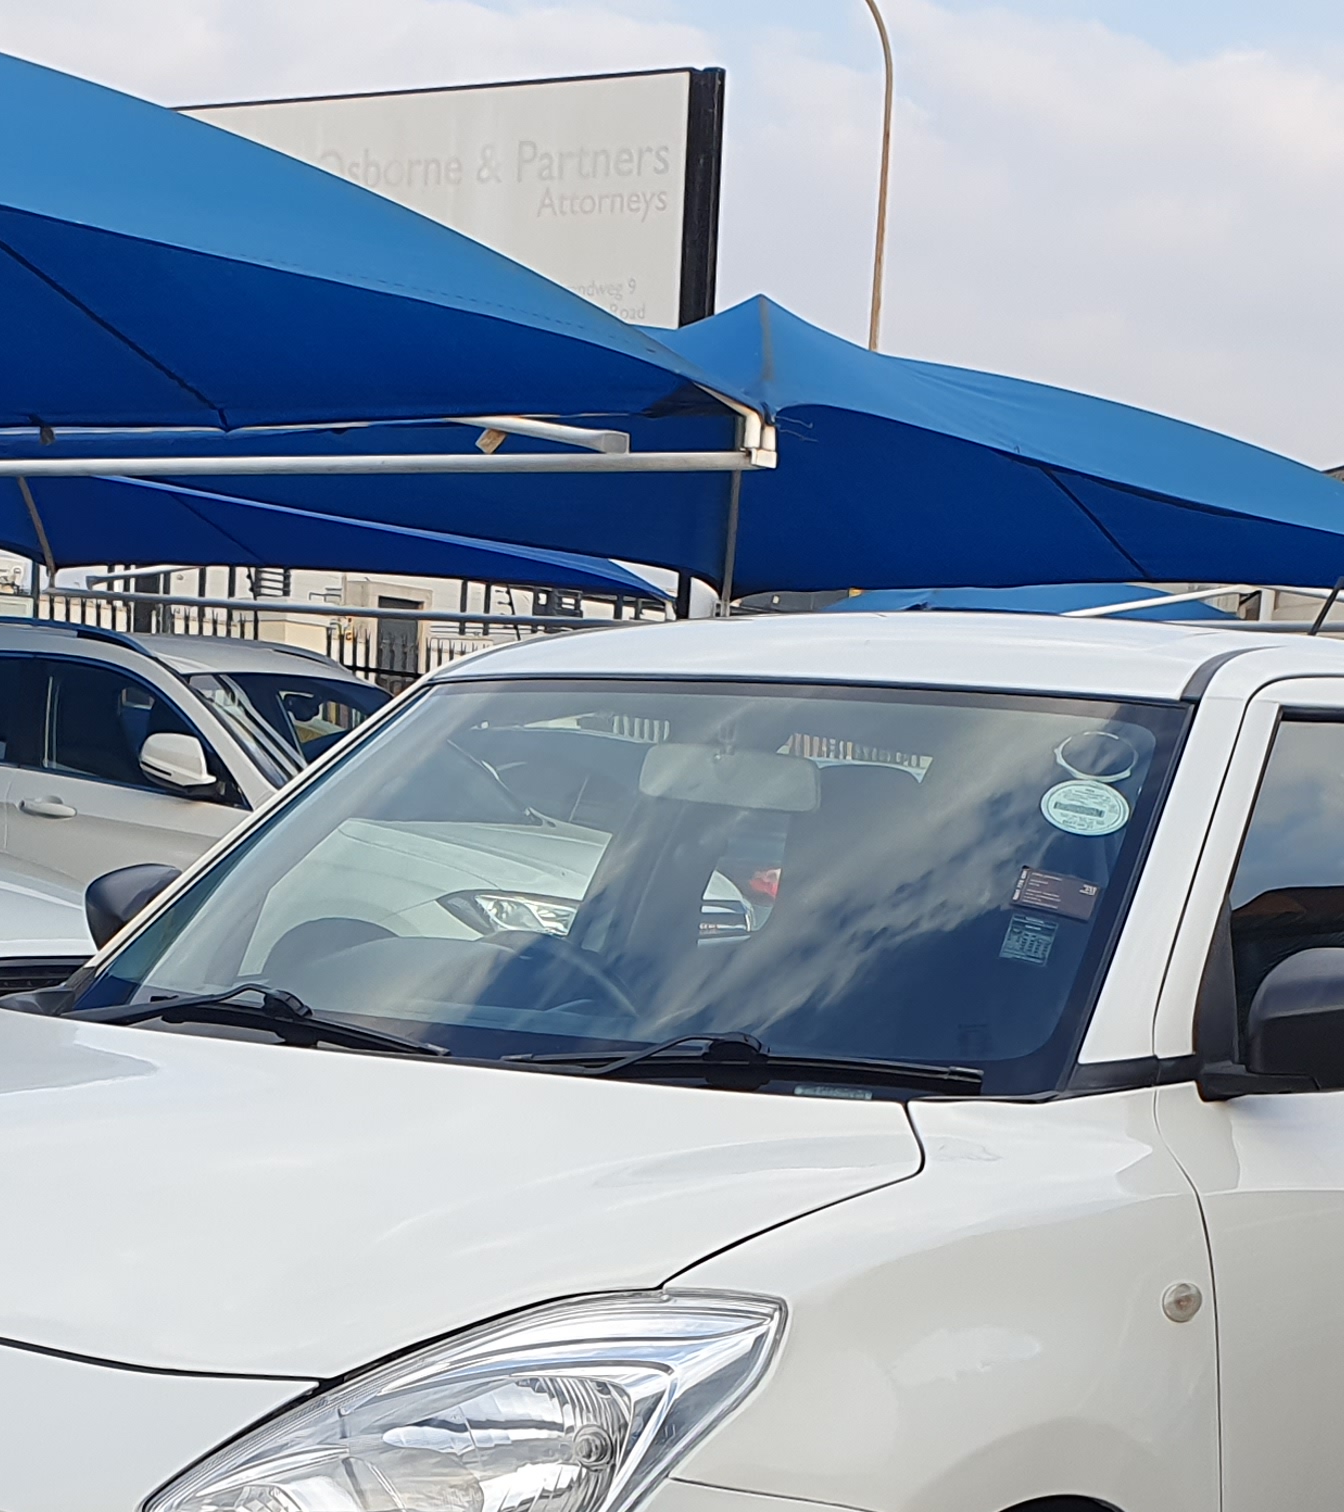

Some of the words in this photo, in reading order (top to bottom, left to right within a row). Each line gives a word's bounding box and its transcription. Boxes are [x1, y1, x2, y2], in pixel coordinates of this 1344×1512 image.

[476, 144, 502, 185] &
[517, 140, 670, 183] Partners
[537, 187, 668, 224] Attorneys
